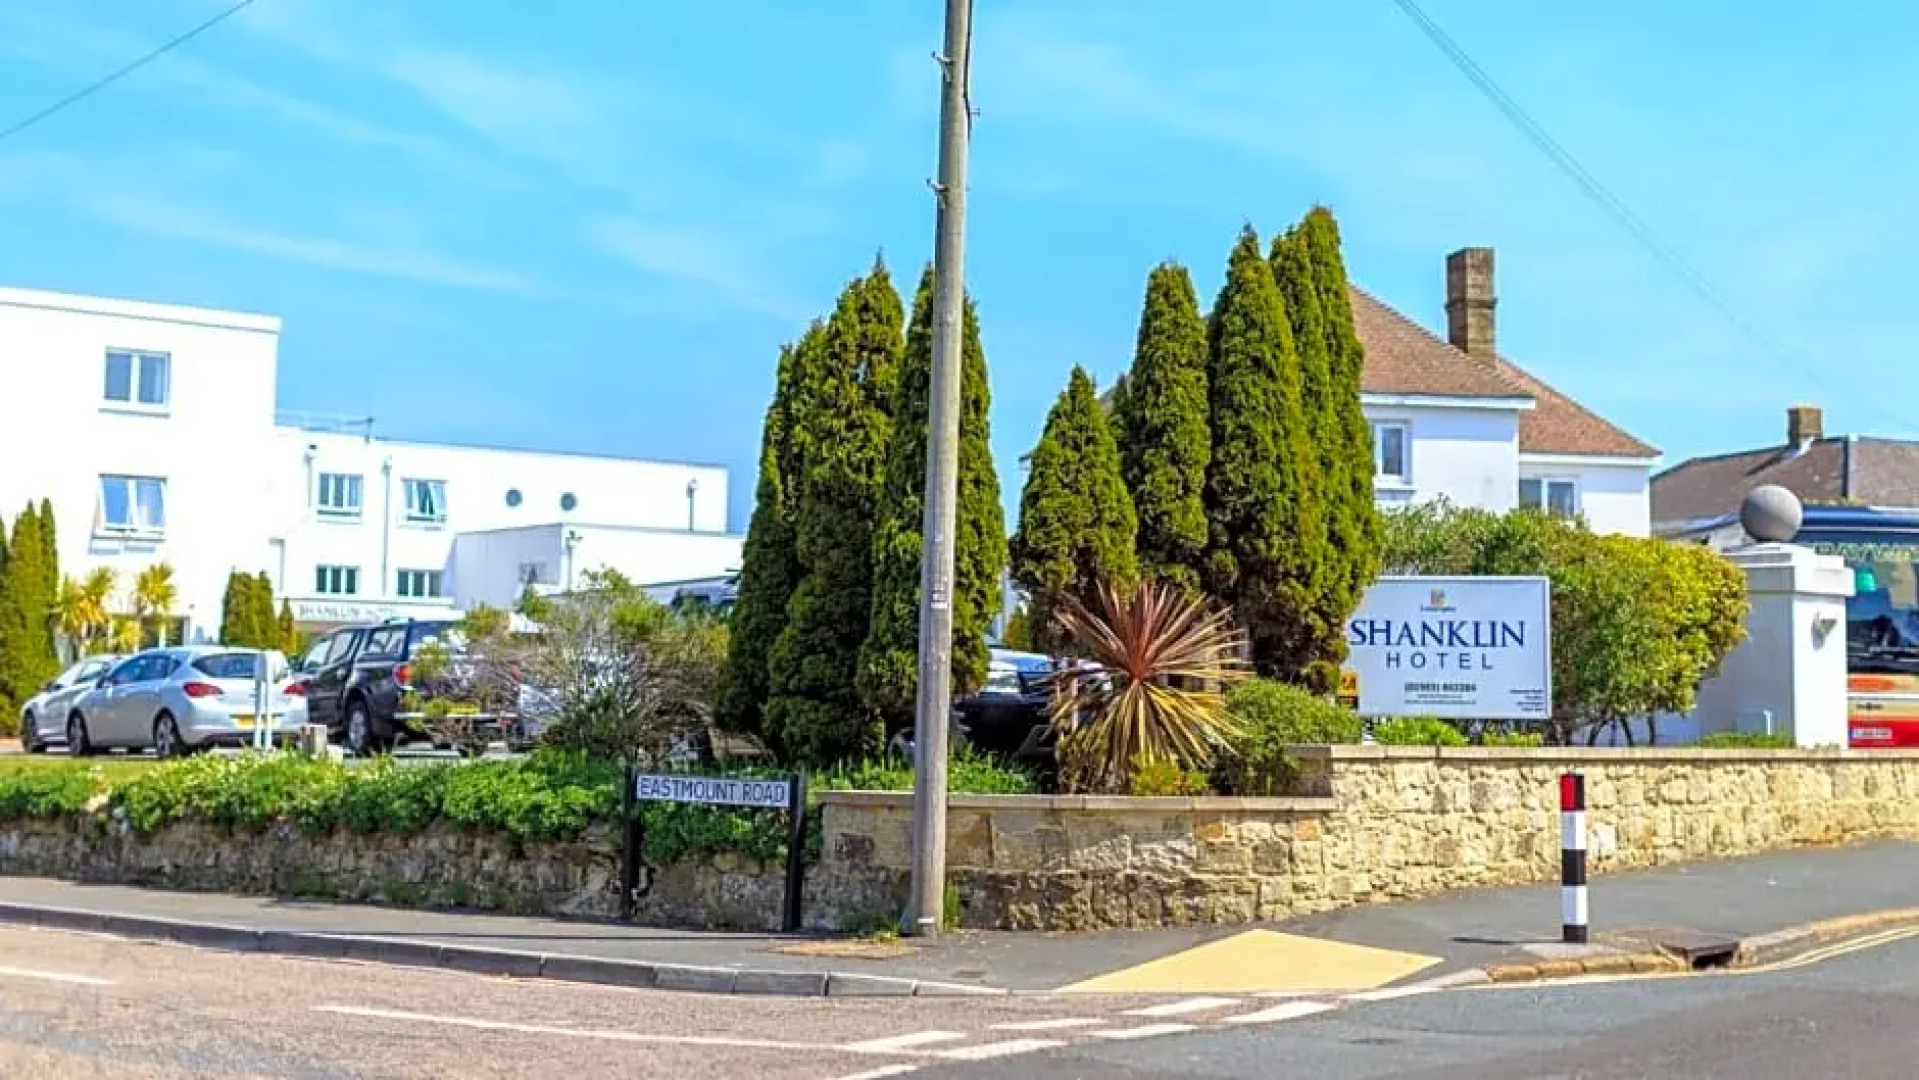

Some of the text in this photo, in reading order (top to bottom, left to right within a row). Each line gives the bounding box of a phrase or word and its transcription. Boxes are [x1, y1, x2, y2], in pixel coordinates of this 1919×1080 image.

[1349, 619, 1526, 648] SHANKLIN
[1386, 652, 1494, 670] HOTEL
[640, 777, 786, 803] EASTMOUNT ROAD
